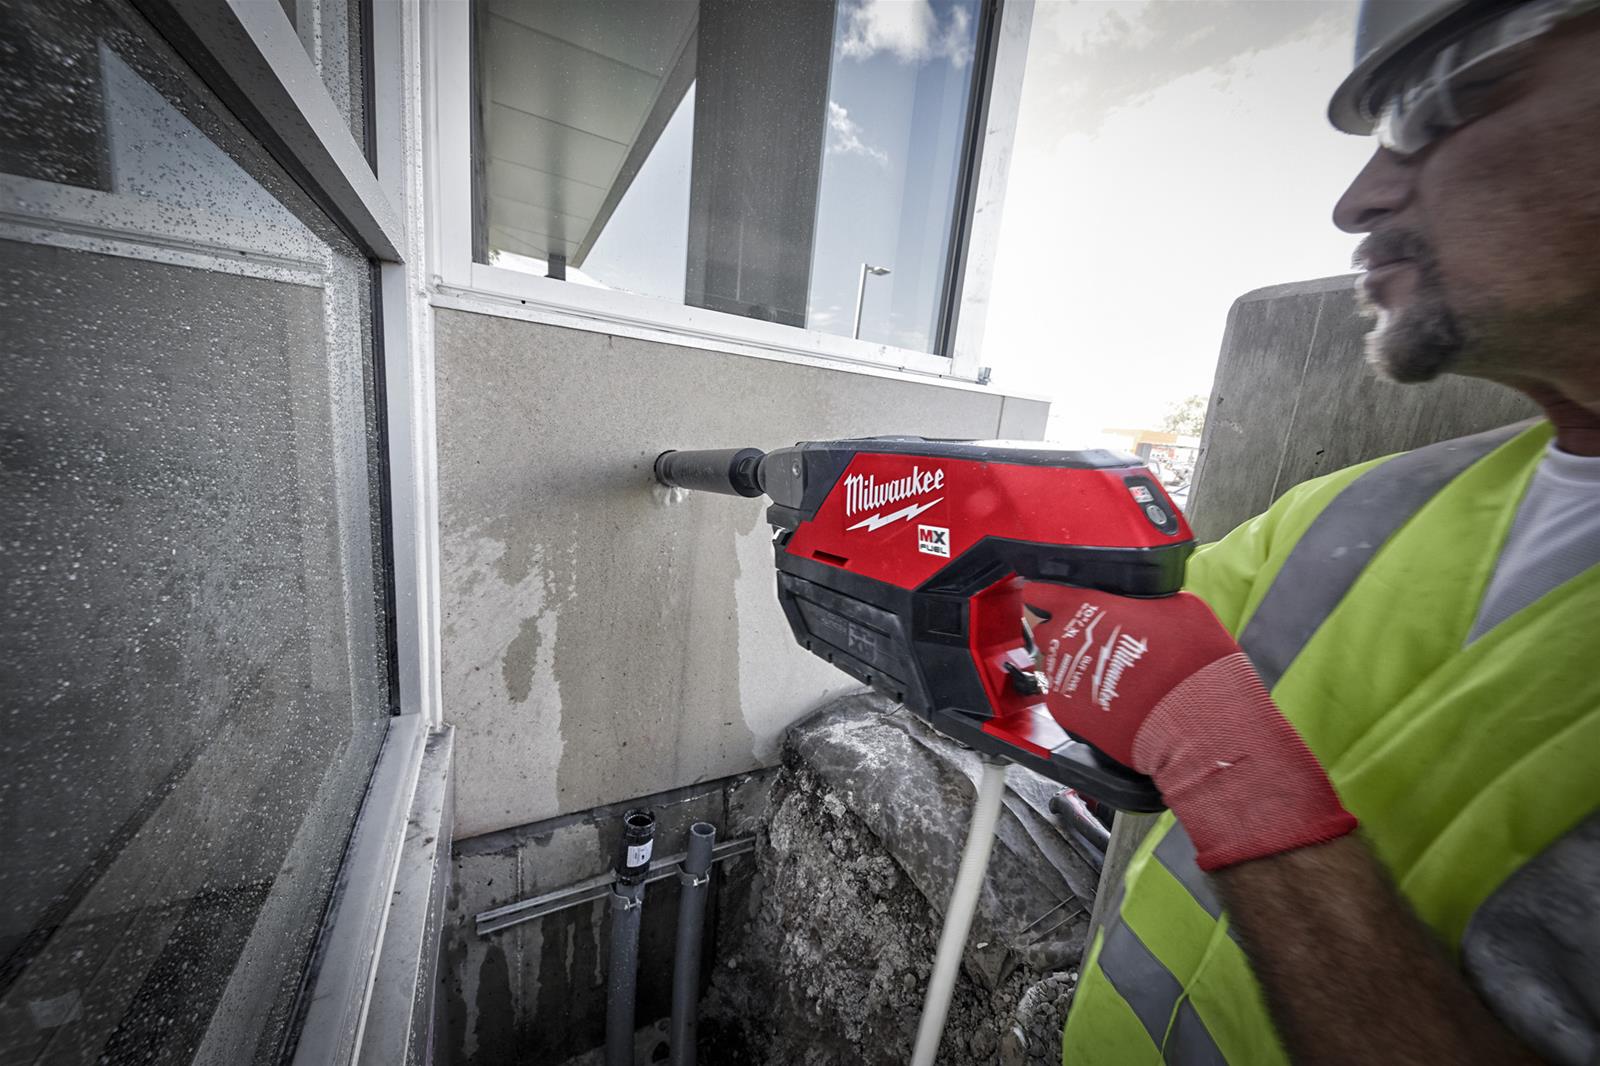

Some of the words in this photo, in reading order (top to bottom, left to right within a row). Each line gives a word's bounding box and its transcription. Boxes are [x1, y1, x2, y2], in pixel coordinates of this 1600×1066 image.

[844, 465, 944, 518] Milwaukee
[920, 529, 946, 545] MX
[920, 544, 947, 554] FUEL
[1098, 634, 1148, 711] Milwaukee
